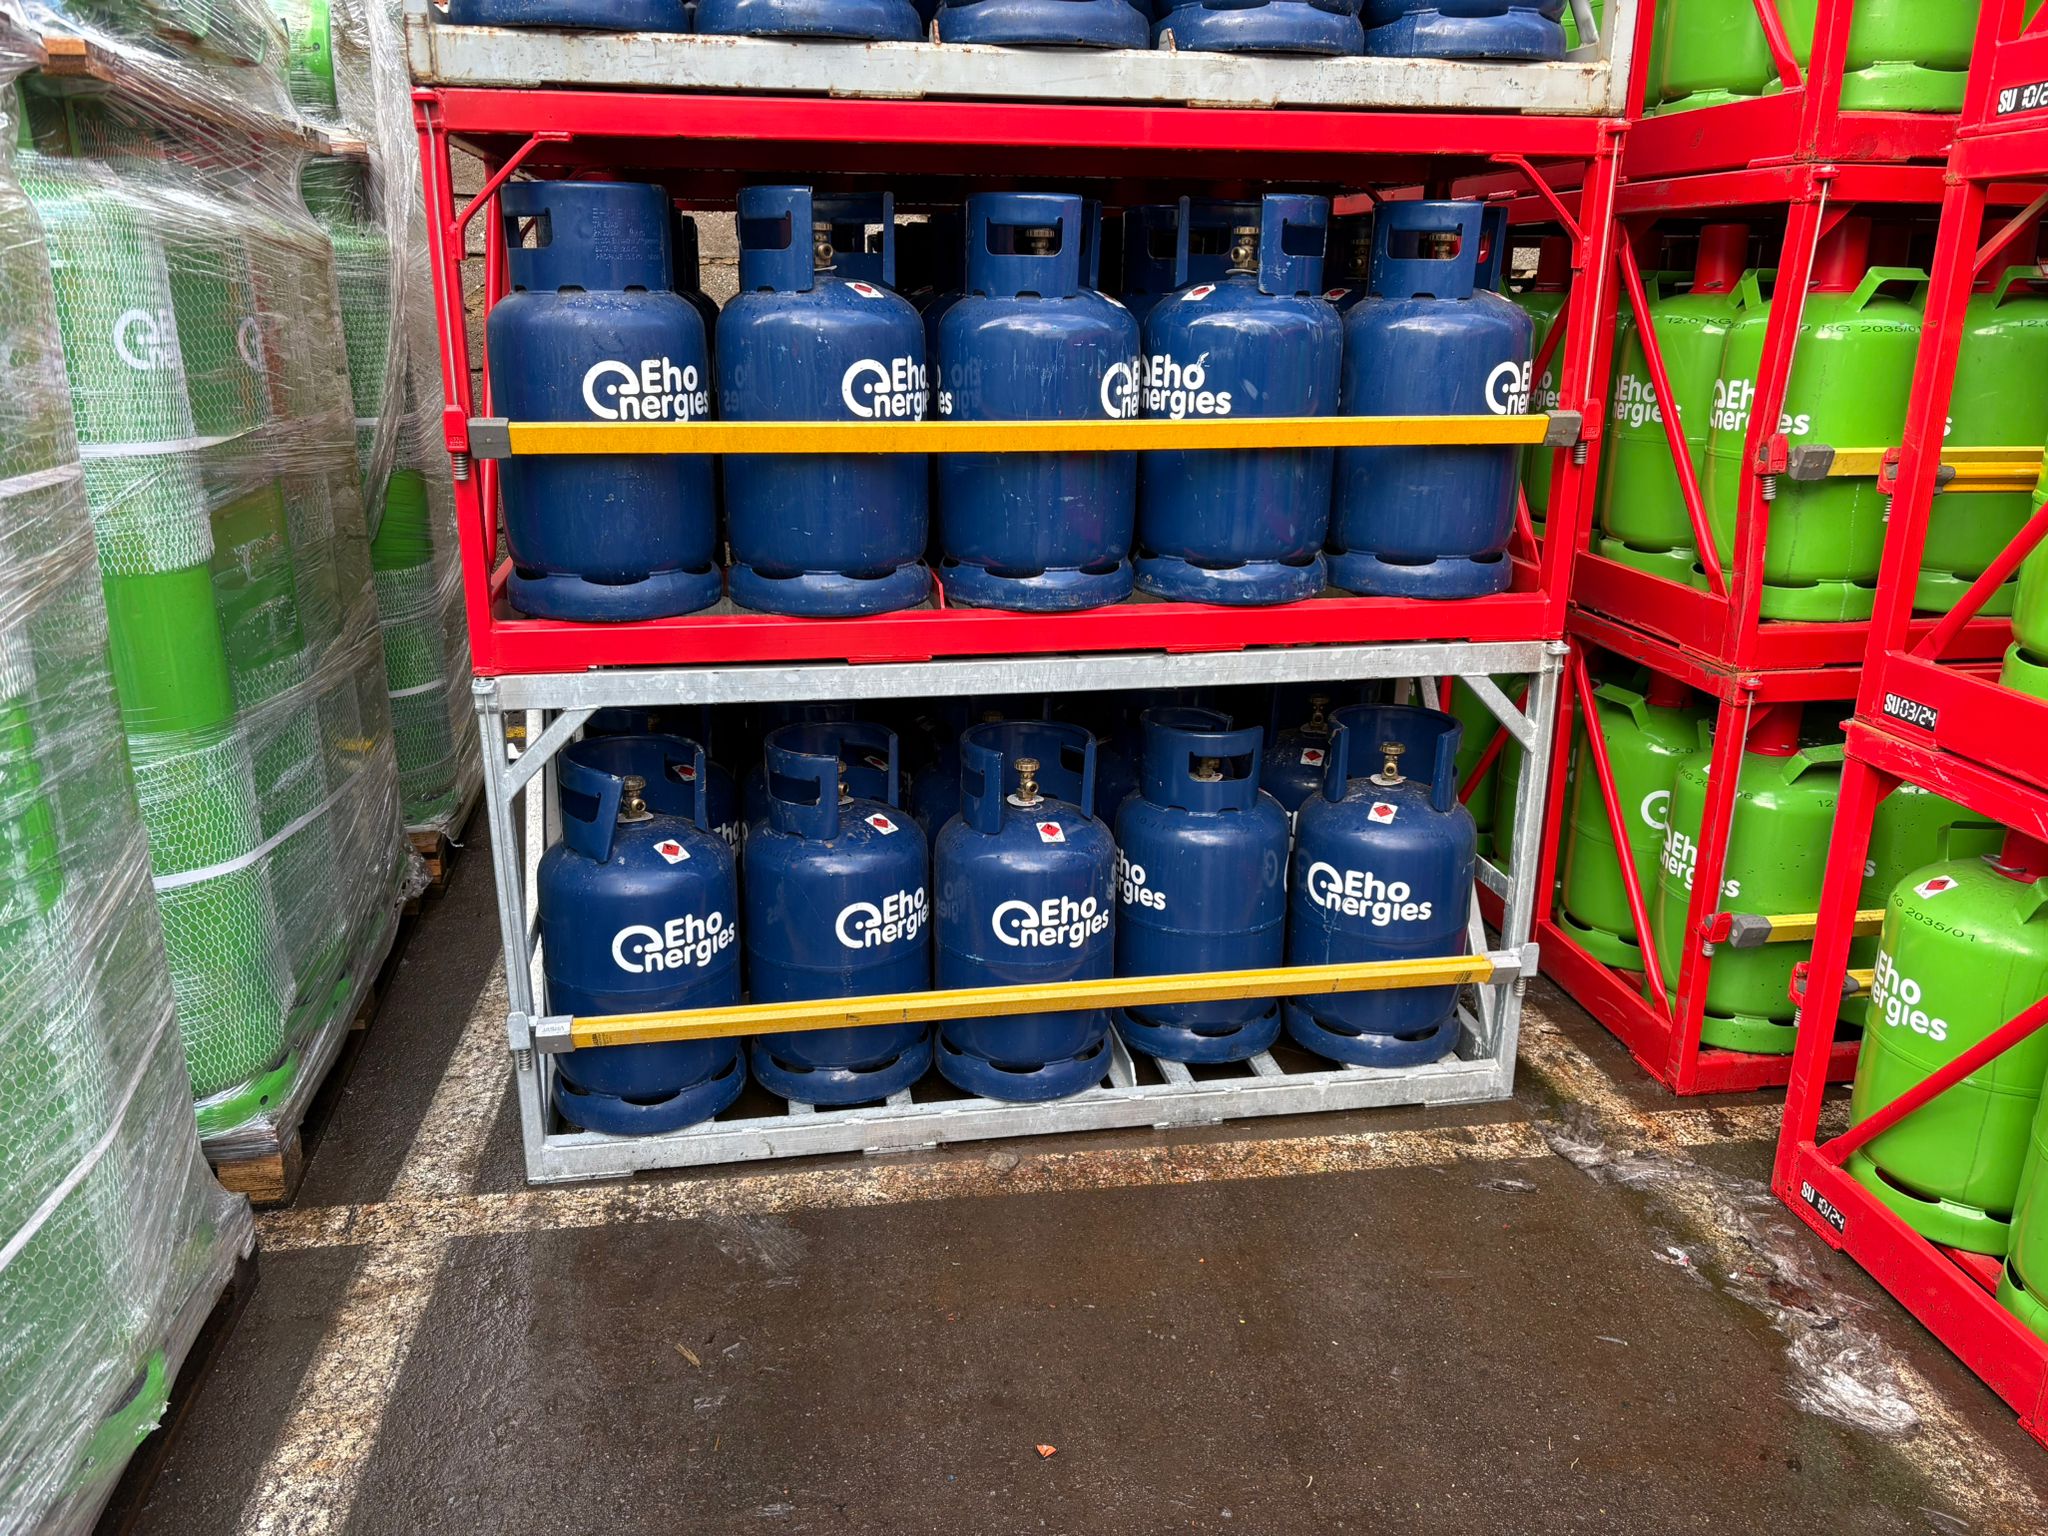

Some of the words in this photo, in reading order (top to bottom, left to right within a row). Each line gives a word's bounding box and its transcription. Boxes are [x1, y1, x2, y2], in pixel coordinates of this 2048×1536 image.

[1997, 89, 2018, 114] SU
[1822, 324, 1851, 333] KG
[641, 356, 698, 394] Eho
[1151, 352, 1206, 390] Eho
[1726, 379, 1755, 410] Eh
[1670, 831, 1698, 866] Eh
[1344, 869, 1411, 901] Eho
[883, 887, 924, 925] Eho
[1041, 896, 1098, 927] Eho
[1892, 893, 1904, 908] KG
[1905, 907, 1976, 943] 2035/01
[664, 911, 722, 949] Eho
[1875, 950, 1921, 1005] Eho
[1801, 1181, 1815, 1203] SU
